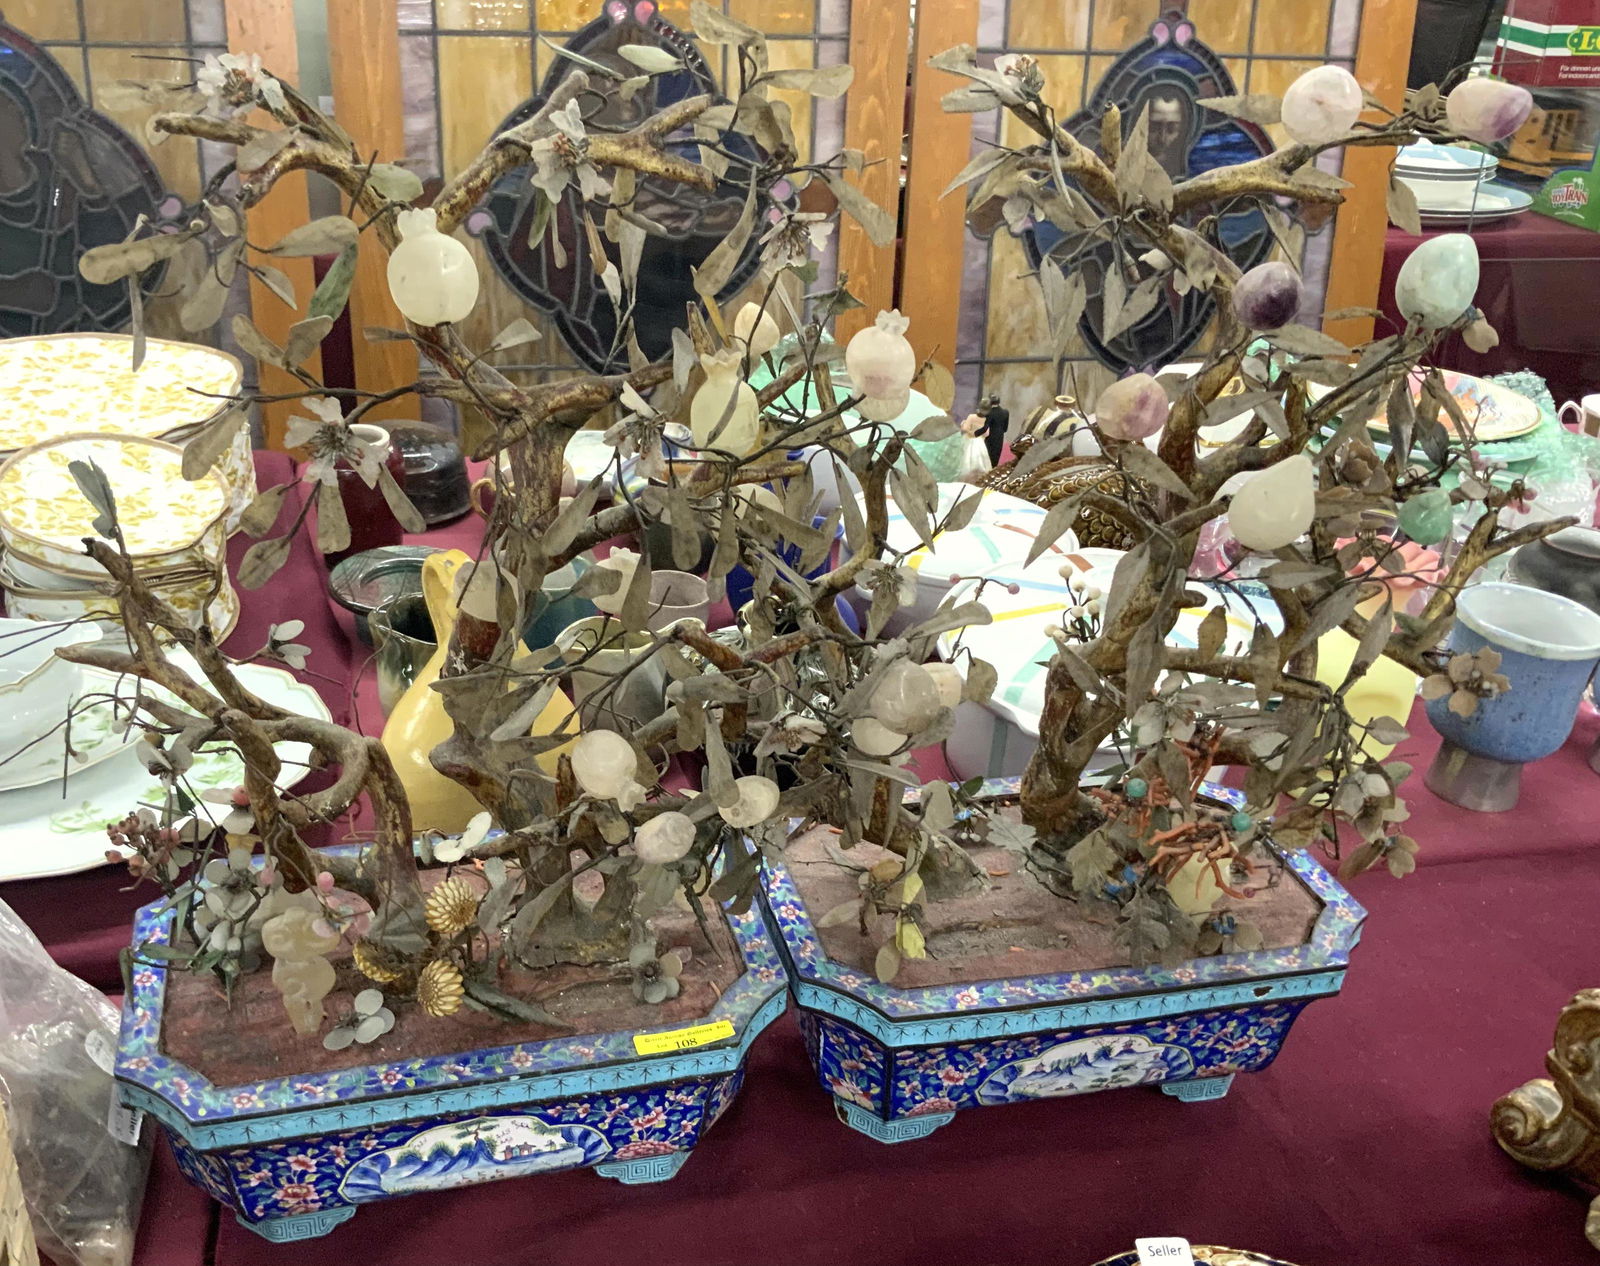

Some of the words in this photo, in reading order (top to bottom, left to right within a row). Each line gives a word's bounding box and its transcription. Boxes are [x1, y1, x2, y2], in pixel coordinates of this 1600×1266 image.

[674, 1038, 698, 1049] 108
[129, 1110, 138, 1136] eller
[1147, 1244, 1182, 1257] Seller
